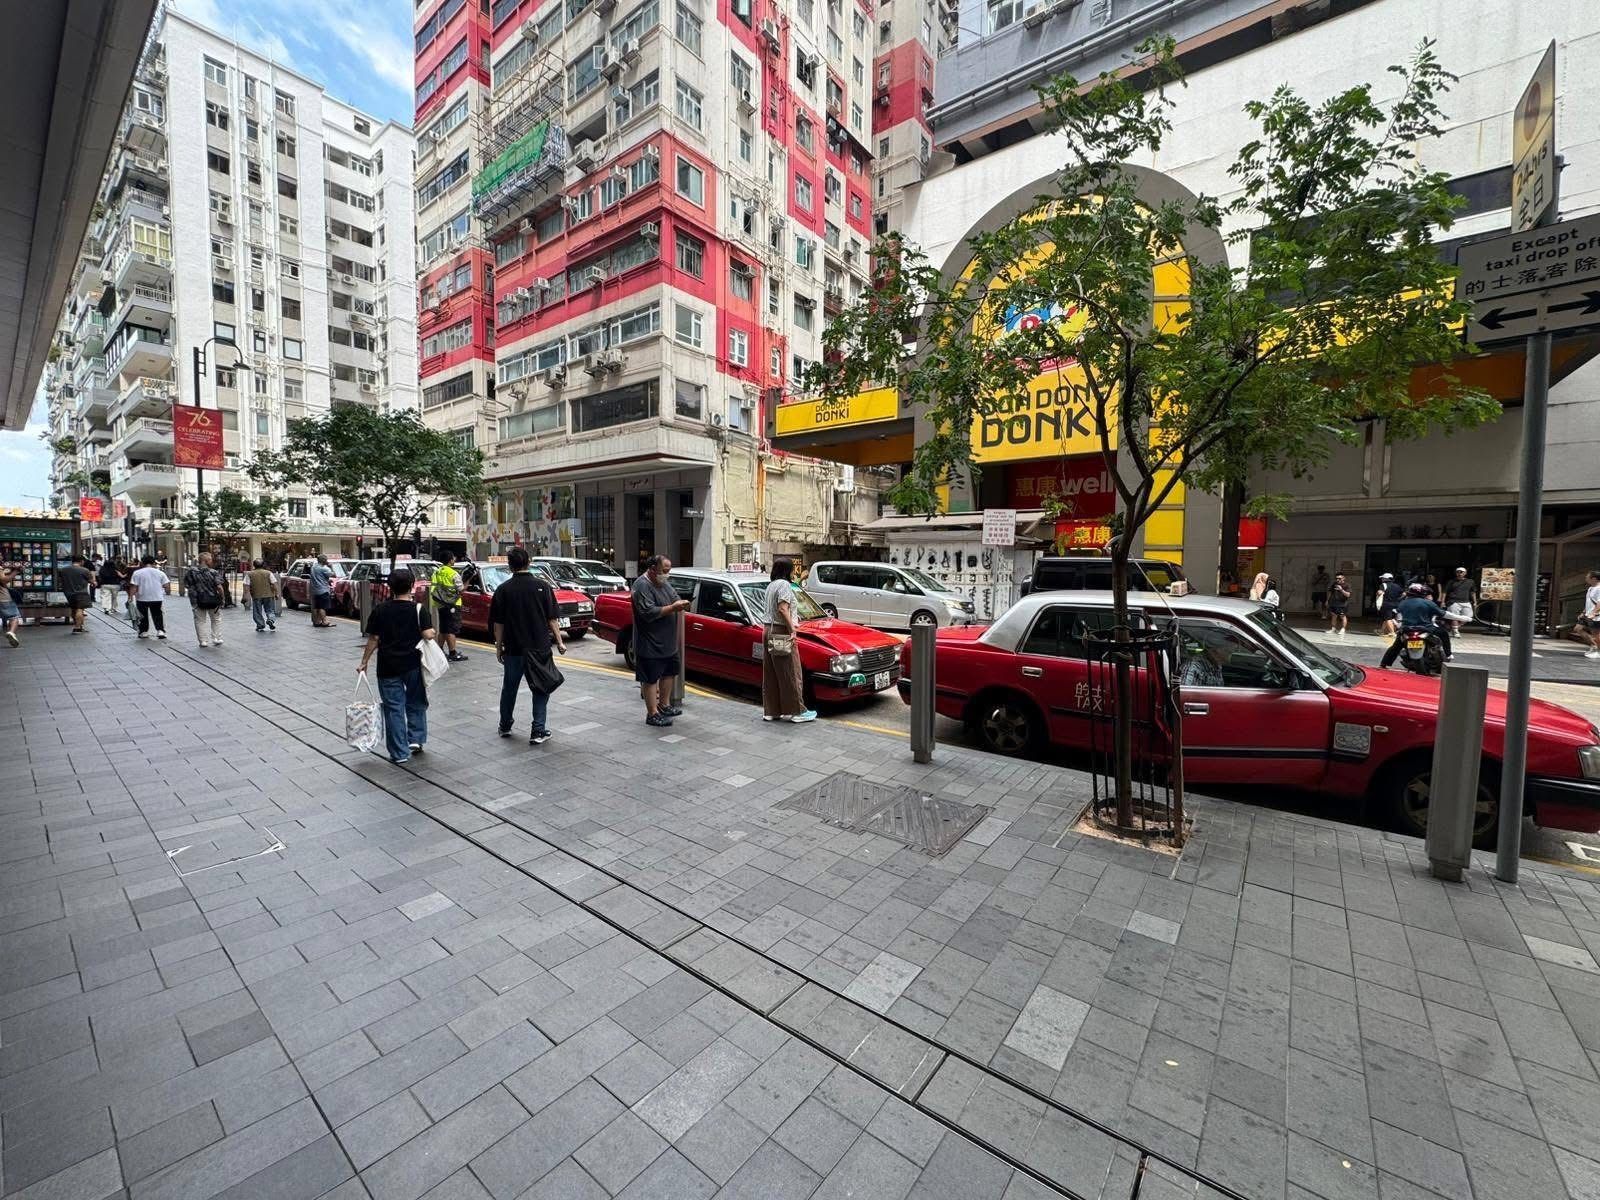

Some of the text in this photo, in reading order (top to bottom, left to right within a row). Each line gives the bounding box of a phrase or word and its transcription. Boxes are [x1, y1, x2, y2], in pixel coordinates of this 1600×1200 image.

[1532, 141, 1548, 172] hrs
[1518, 174, 1544, 230] 全日
[1512, 228, 1579, 253] Except
[1486, 254, 1520, 271] taxi
[1526, 245, 1569, 265] drop
[186, 410, 211, 427] 76
[815, 408, 849, 423] DONKI
[176, 426, 221, 437] CELEBRATING
[1015, 475, 1058, 497] 惠康
[1073, 526, 1112, 545] 惠康
[1075, 681, 1102, 698] 的士
[1074, 694, 1105, 711] TAX
